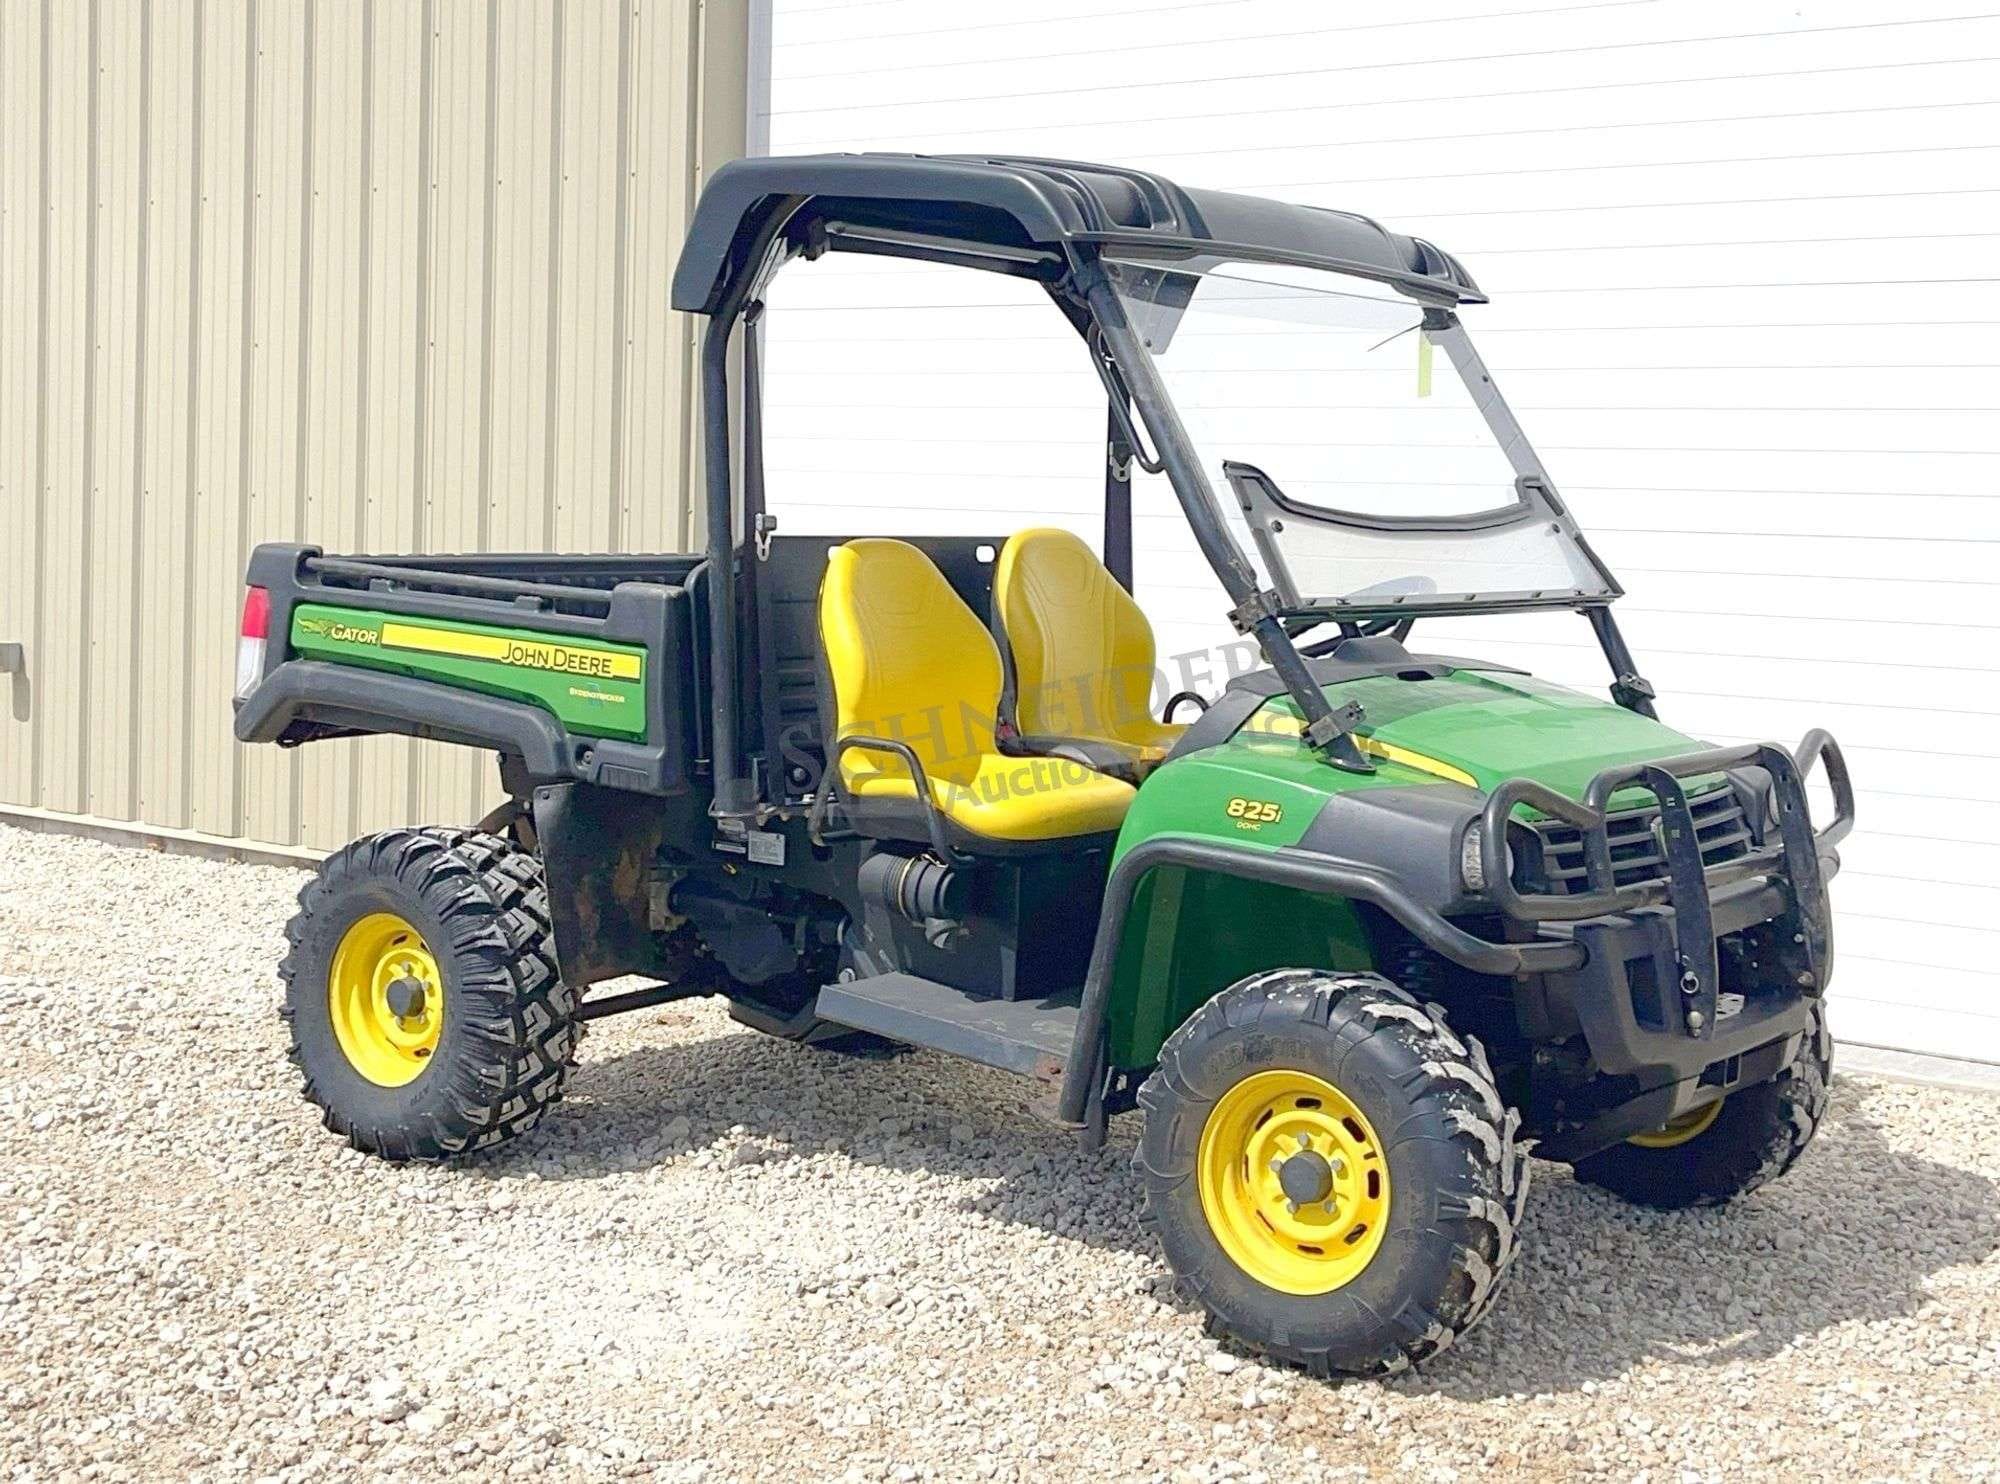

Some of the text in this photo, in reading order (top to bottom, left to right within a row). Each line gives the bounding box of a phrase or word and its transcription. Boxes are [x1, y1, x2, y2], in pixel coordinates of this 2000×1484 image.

[331, 623, 378, 645] GATOR
[501, 642, 613, 675] JOHN DEERE
